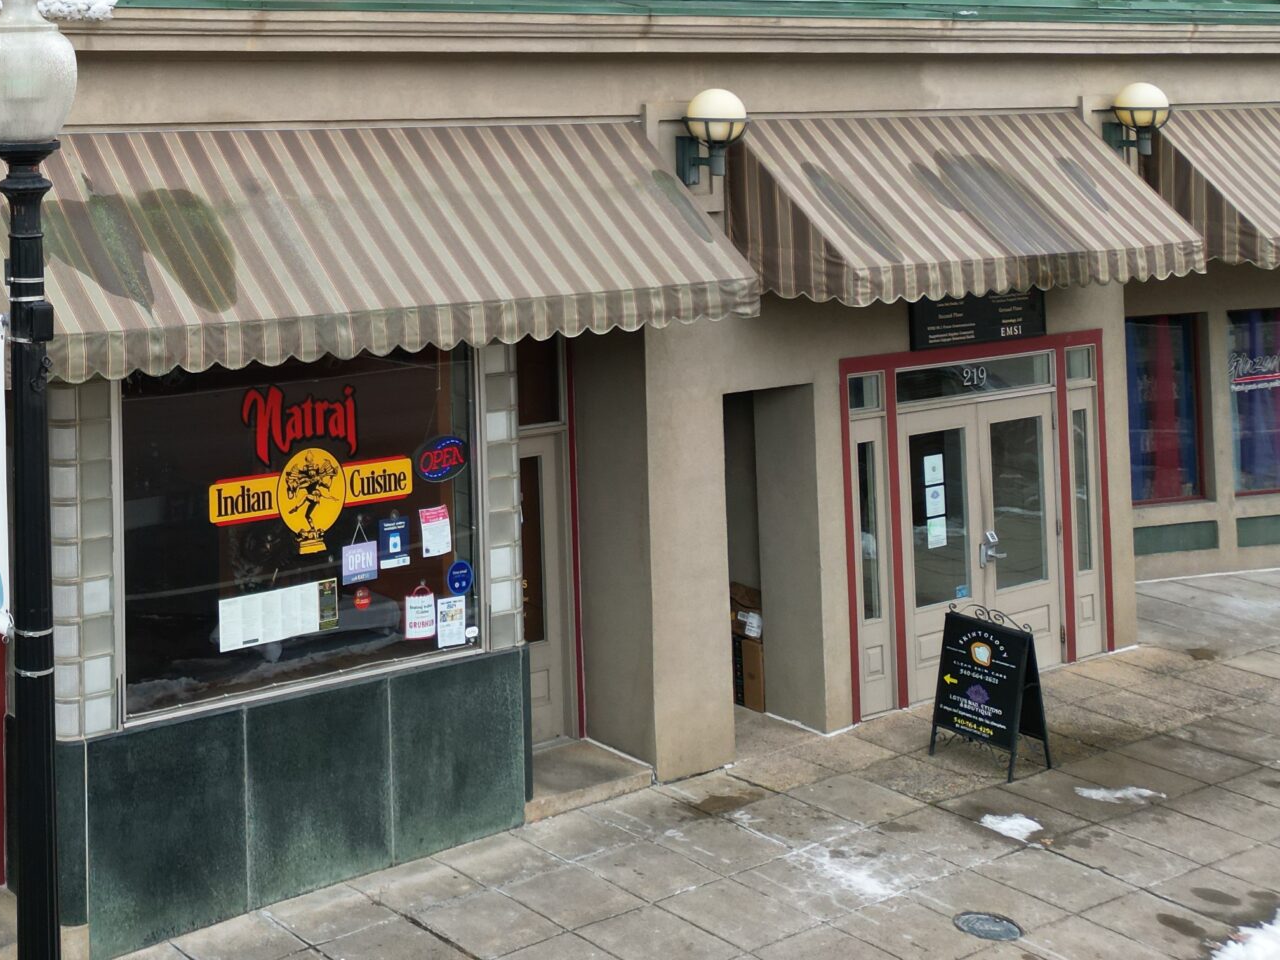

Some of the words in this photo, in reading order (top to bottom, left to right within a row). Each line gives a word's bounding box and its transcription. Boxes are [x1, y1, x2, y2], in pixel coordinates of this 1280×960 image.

[1001, 325, 1022, 338] EMSI
[962, 366, 987, 387] 219
[242, 385, 358, 466] Natraj
[420, 446, 464, 473] OPEN
[216, 485, 273, 518] Indian
[349, 468, 407, 498] Cuisine
[348, 551, 373, 571] OPEN
